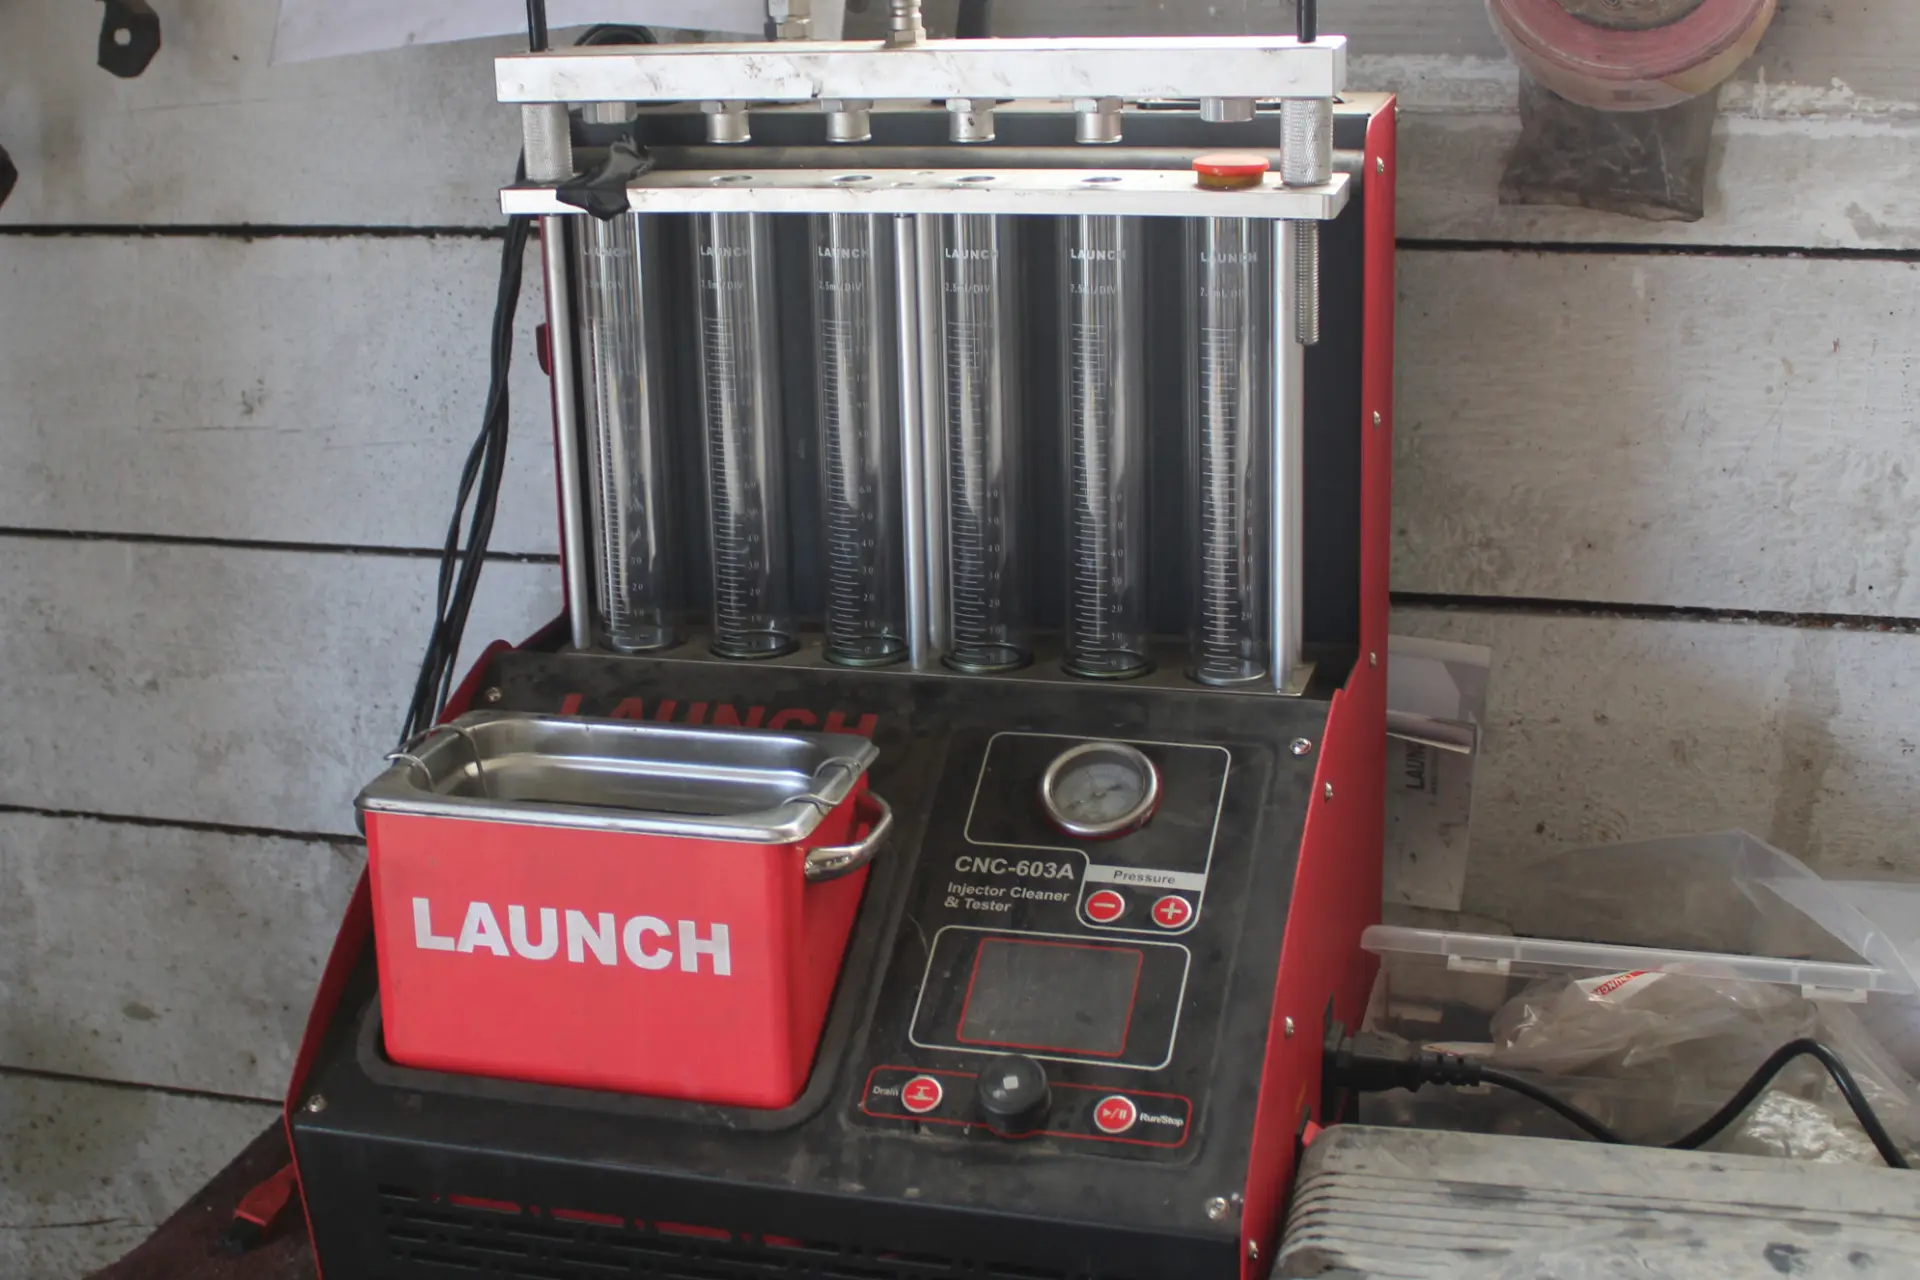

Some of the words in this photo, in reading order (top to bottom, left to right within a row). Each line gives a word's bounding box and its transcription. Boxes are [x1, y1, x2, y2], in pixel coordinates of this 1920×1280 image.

[818, 245, 870, 260] LAUNCH
[945, 247, 998, 260] LAUNCH
[1070, 247, 1125, 260] LAUNCH
[954, 855, 1075, 881] CNC-603A
[1112, 869, 1177, 885] Pressure
[946, 881, 1007, 897] Injector
[1009, 886, 1071, 902] Cleaner
[943, 895, 960, 909] &
[964, 897, 1012, 913] Tester
[411, 896, 732, 976] LAUNCH
[872, 1084, 899, 1097] Drain
[1139, 1112, 1185, 1128] Run/Stop
